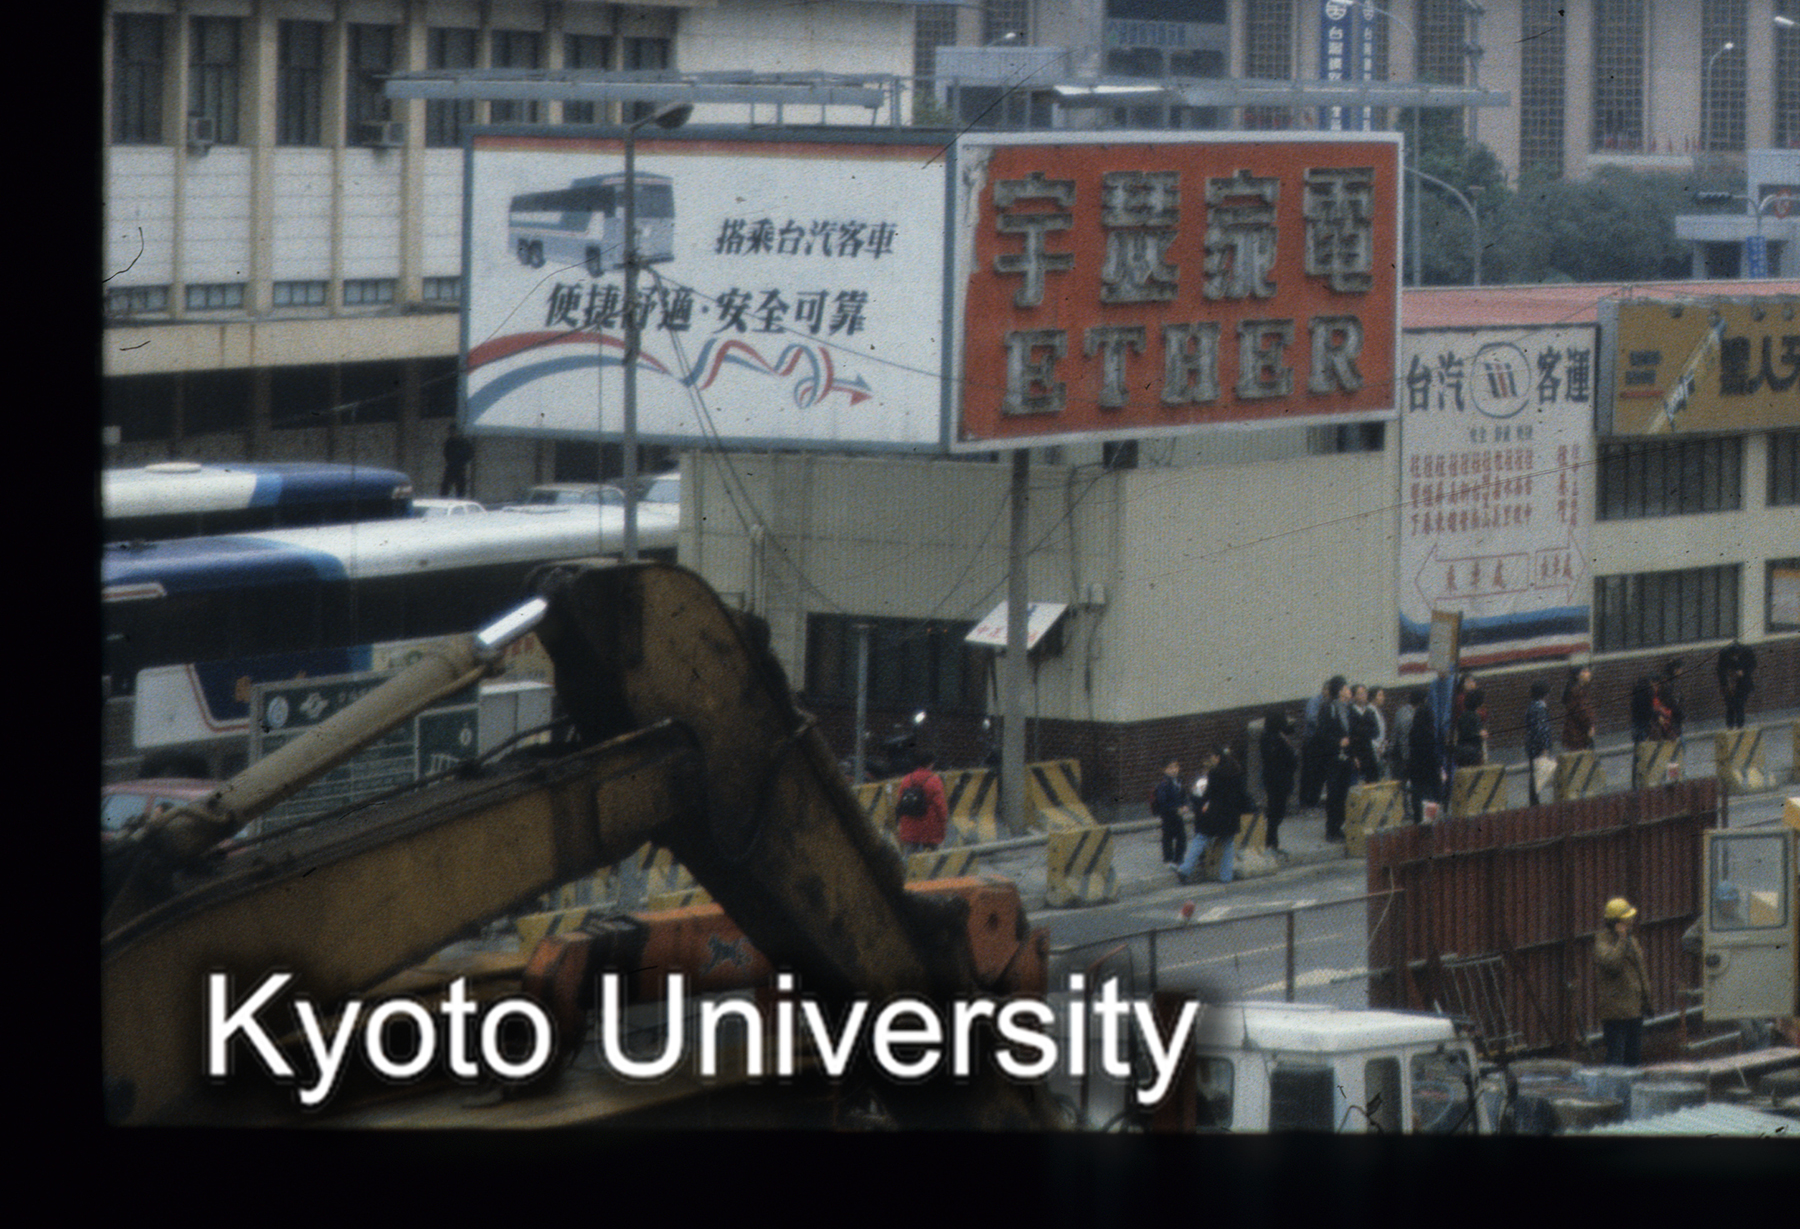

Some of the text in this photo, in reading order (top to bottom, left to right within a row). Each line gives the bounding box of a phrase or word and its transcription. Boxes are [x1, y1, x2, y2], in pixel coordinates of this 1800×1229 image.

[714, 217, 898, 260] 搭乘台汽客車
[1002, 314, 1365, 415] ETHER
[1406, 351, 1465, 413] 台汽
[1537, 345, 1590, 404] 客運
